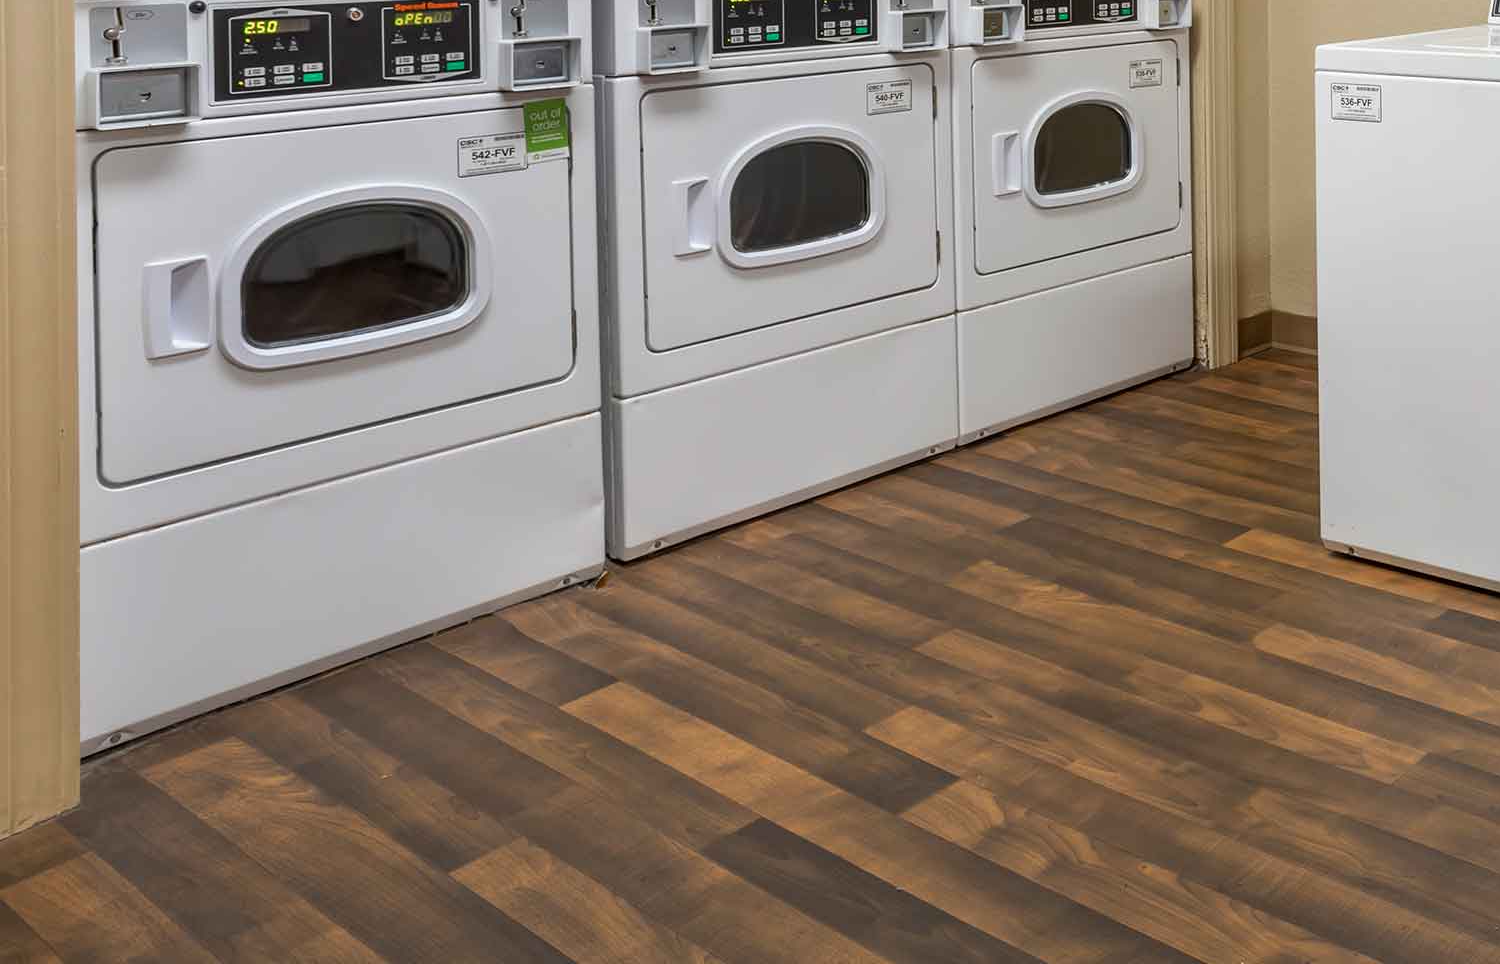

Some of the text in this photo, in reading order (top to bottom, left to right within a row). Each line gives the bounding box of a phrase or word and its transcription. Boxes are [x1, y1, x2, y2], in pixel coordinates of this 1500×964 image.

[1340, 97, 1373, 107] 536-FVF
[529, 109, 549, 121] out
[471, 147, 516, 161] 542-FVF
